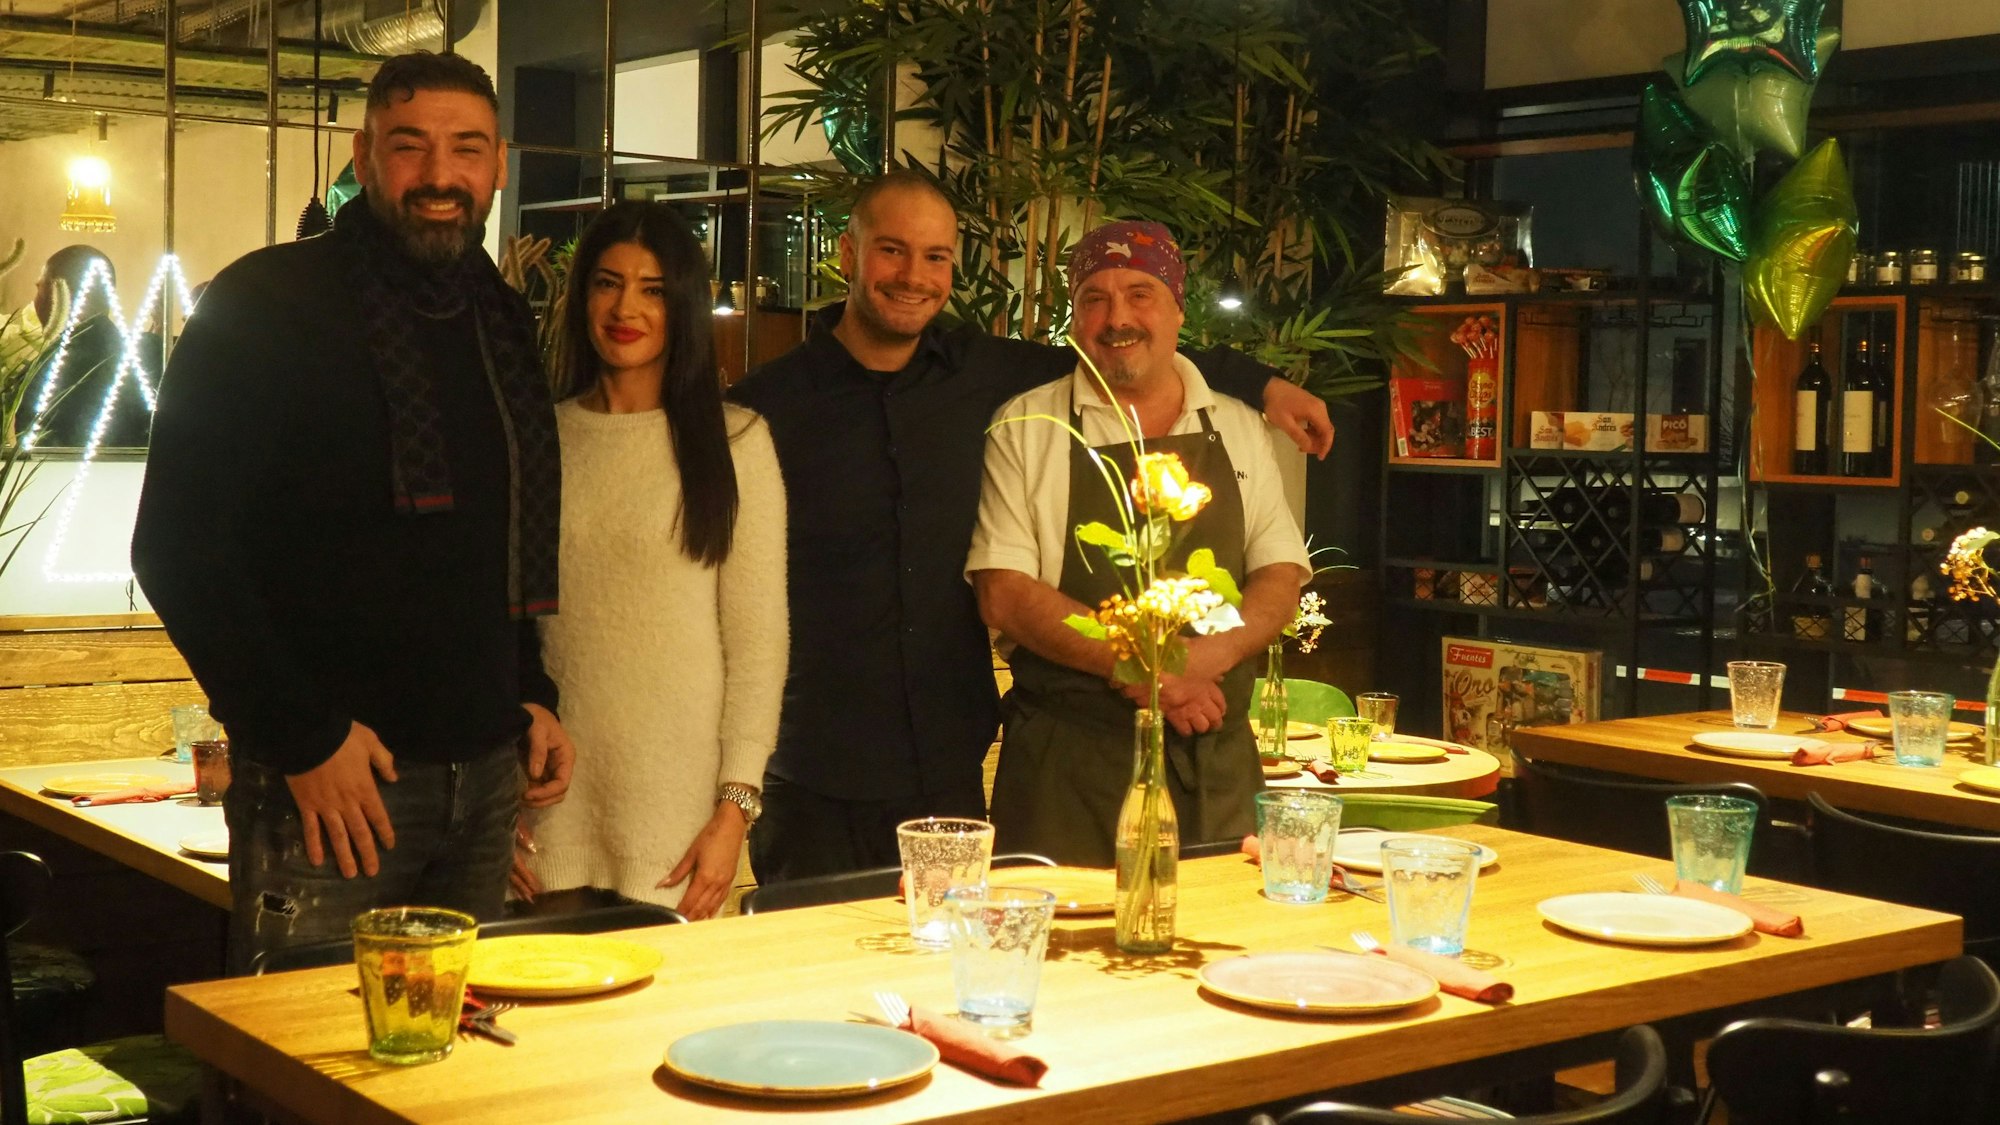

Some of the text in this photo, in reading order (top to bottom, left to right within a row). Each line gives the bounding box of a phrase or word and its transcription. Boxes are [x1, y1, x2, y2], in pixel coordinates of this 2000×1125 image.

[1470, 426, 1494, 437] BEST
[1449, 646, 1487, 664] Fuentes
[1454, 670, 1496, 697] Oro
